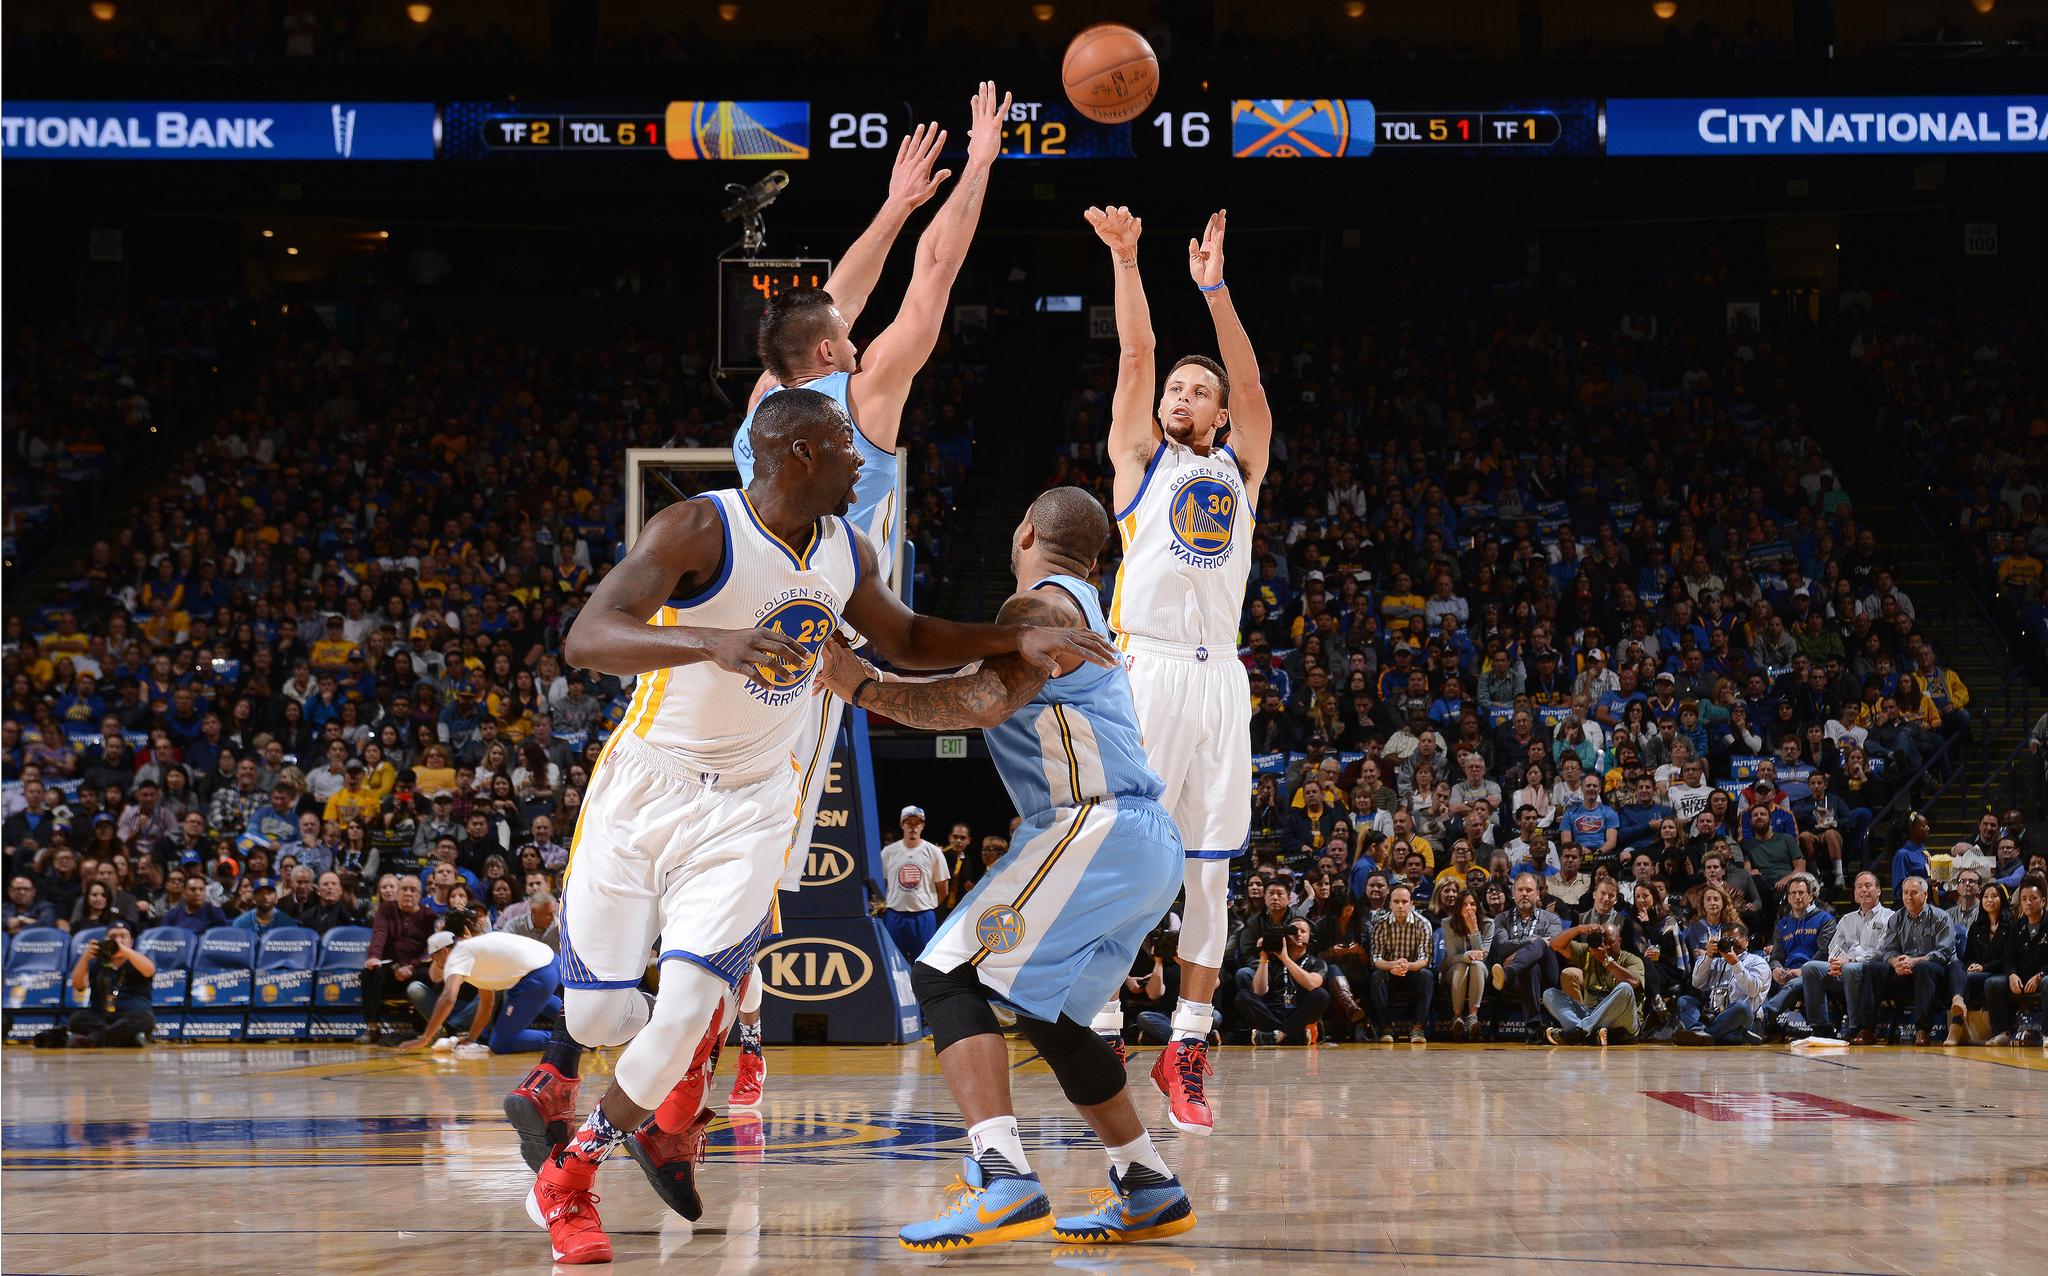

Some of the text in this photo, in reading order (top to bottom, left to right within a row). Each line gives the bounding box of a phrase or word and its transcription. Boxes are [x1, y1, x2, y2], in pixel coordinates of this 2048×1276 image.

[2, 112, 274, 147] TIONAL BANK
[500, 122, 550, 144] TF 2
[570, 123, 656, 145] TOL 6 1
[829, 113, 888, 149] 26
[1153, 112, 1211, 148] 16
[1382, 119, 1469, 141] TOL 5 1
[1493, 118, 1535, 141] TF 1
[1699, 109, 1784, 143] CITY
[1791, 108, 2001, 143] NATIONAL
[1968, 236, 1995, 252] 109
[1170, 468, 1212, 492] GOLDEN
[1207, 494, 1232, 516] 30
[755, 588, 809, 619] GOLDEN
[797, 619, 830, 644] 23
[1196, 650, 1208, 660] W
[942, 738, 962, 754] EXIT
[816, 810, 849, 828] SN
[802, 852, 841, 877] IA
[255, 969, 313, 987] AUTHENTIC
[771, 952, 853, 986] KIA
[217, 980, 239, 990] FAN
[279, 980, 302, 991] FAN
[247, 1028, 296, 1036] EXPRESS
[249, 1021, 306, 1030] AMERICAN
[309, 1028, 358, 1037] EXPRESS
[311, 1022, 369, 1030] AMERICAN
